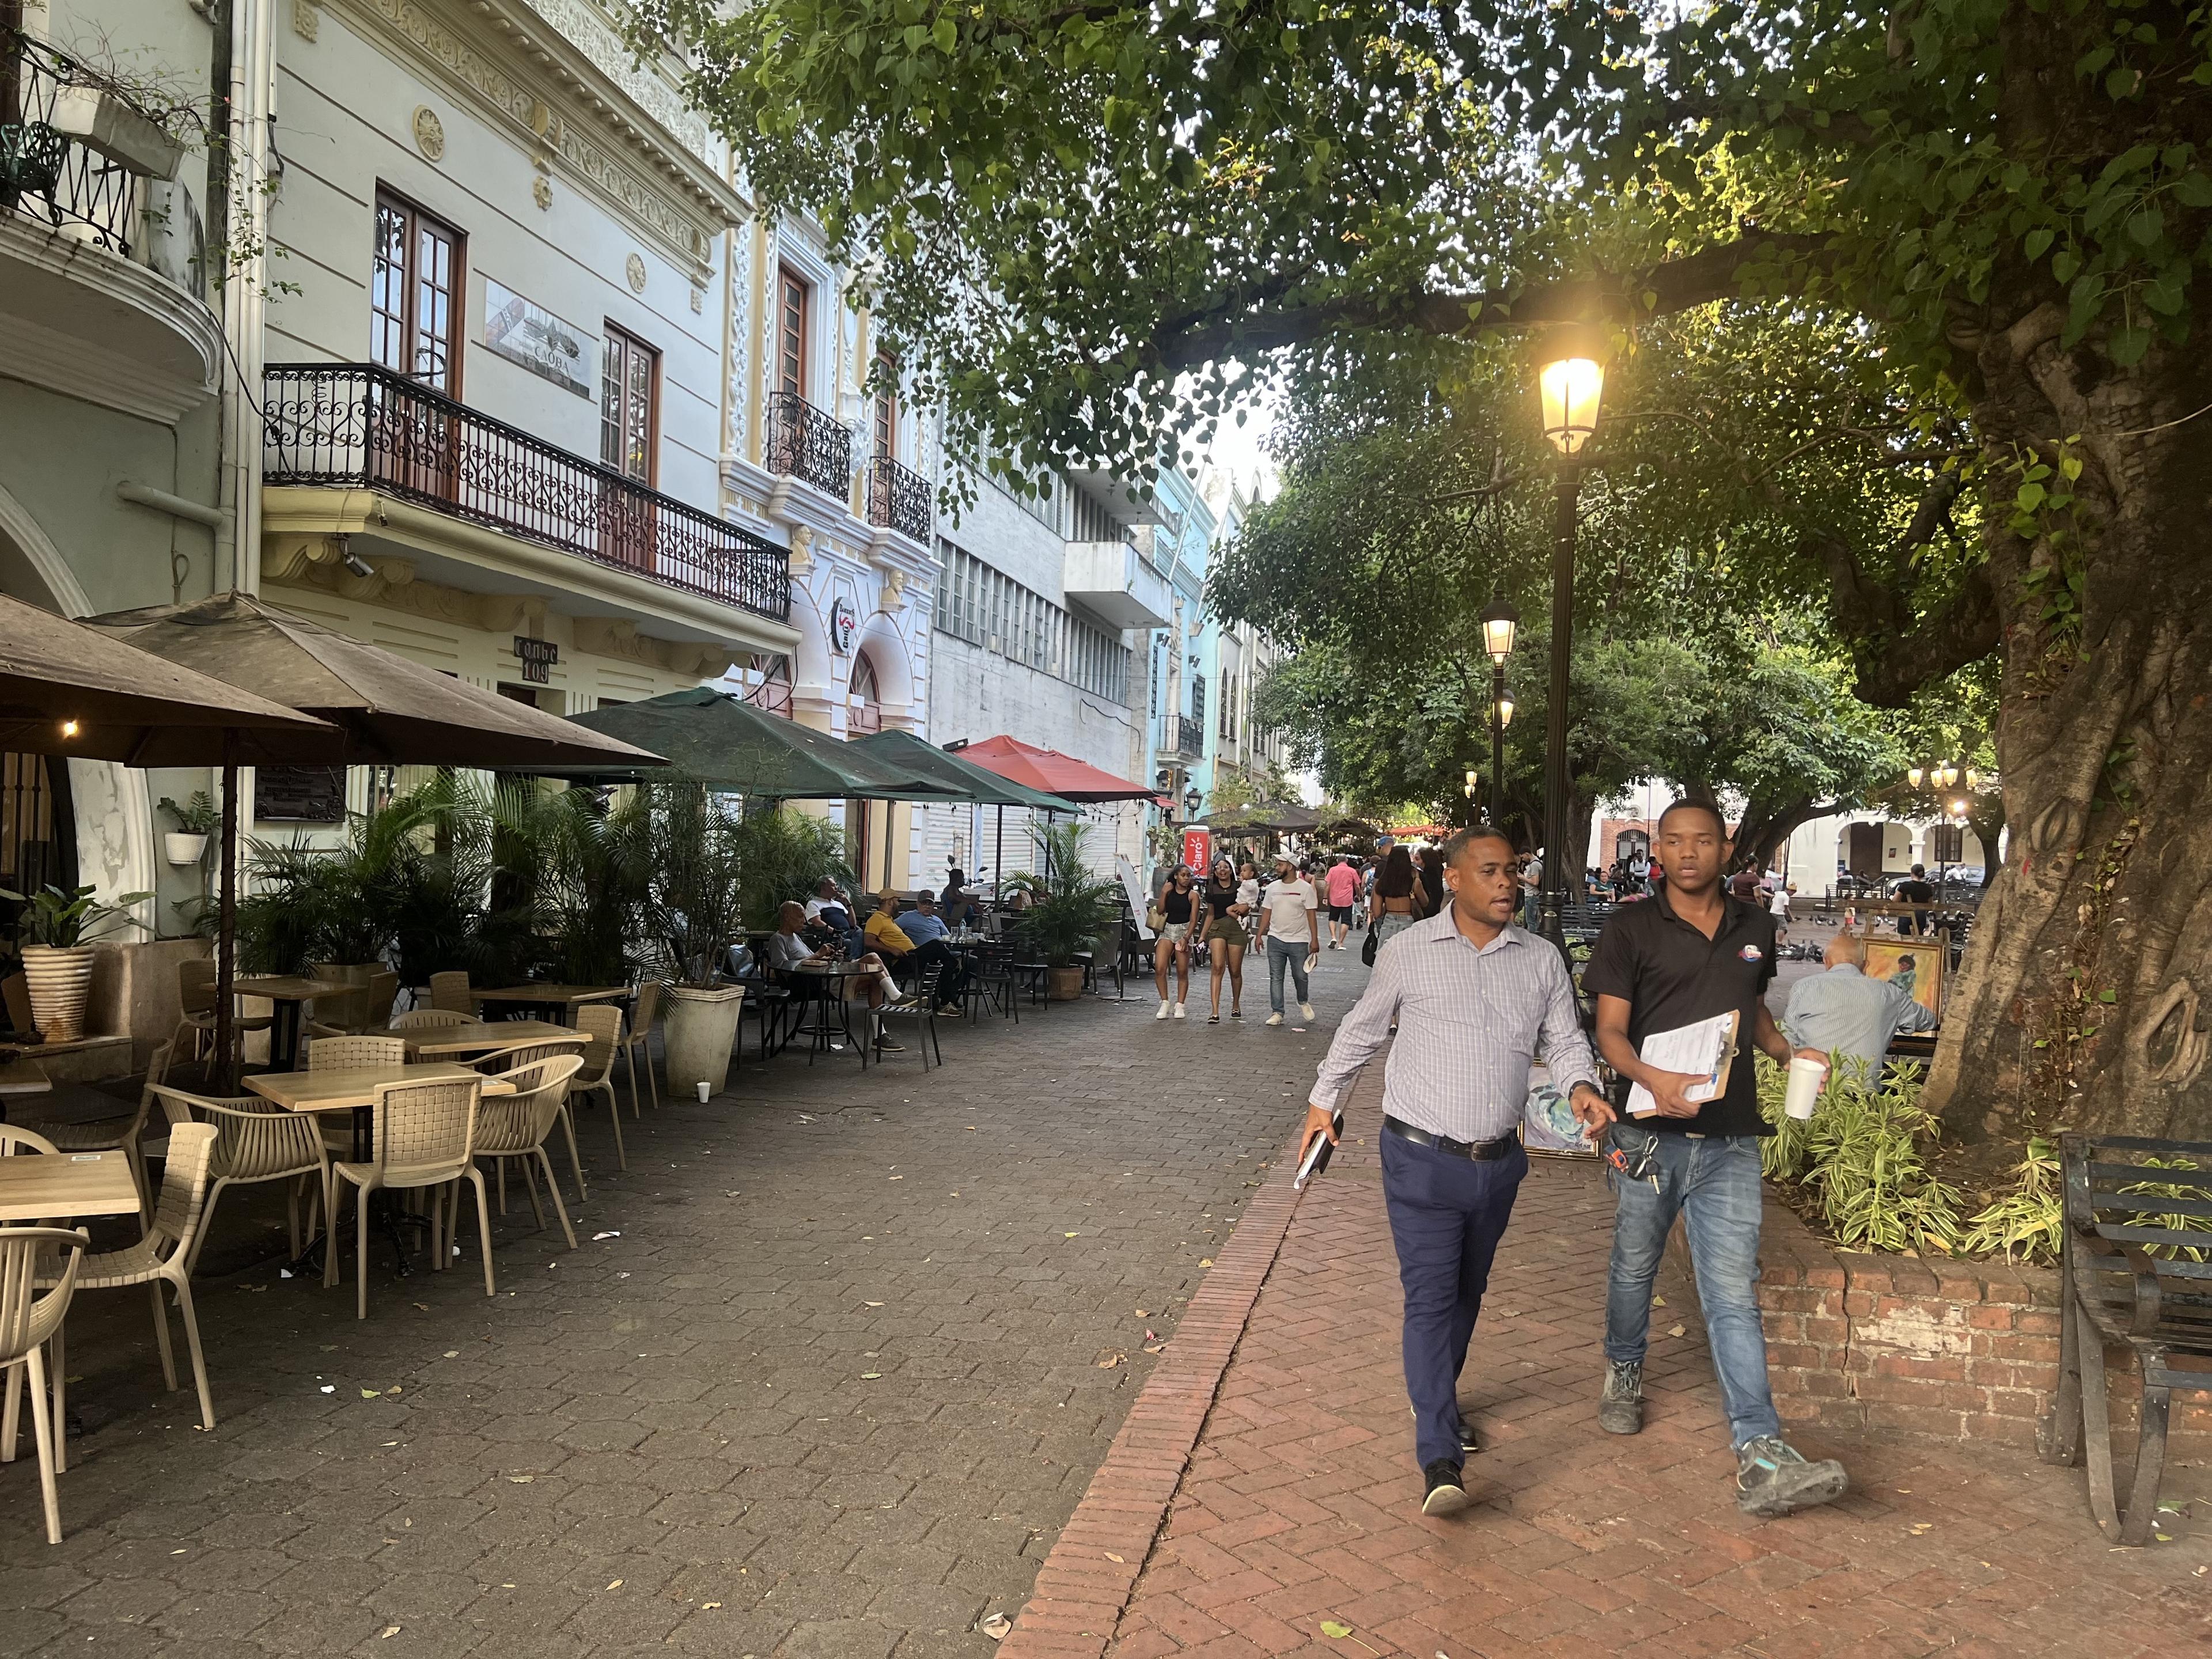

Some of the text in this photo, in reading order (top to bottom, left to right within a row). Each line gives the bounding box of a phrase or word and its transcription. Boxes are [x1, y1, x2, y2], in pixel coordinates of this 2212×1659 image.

[535, 347, 570, 375] CAOBA
[524, 662, 548, 682] 109
[1192, 842, 1203, 871] Claro
